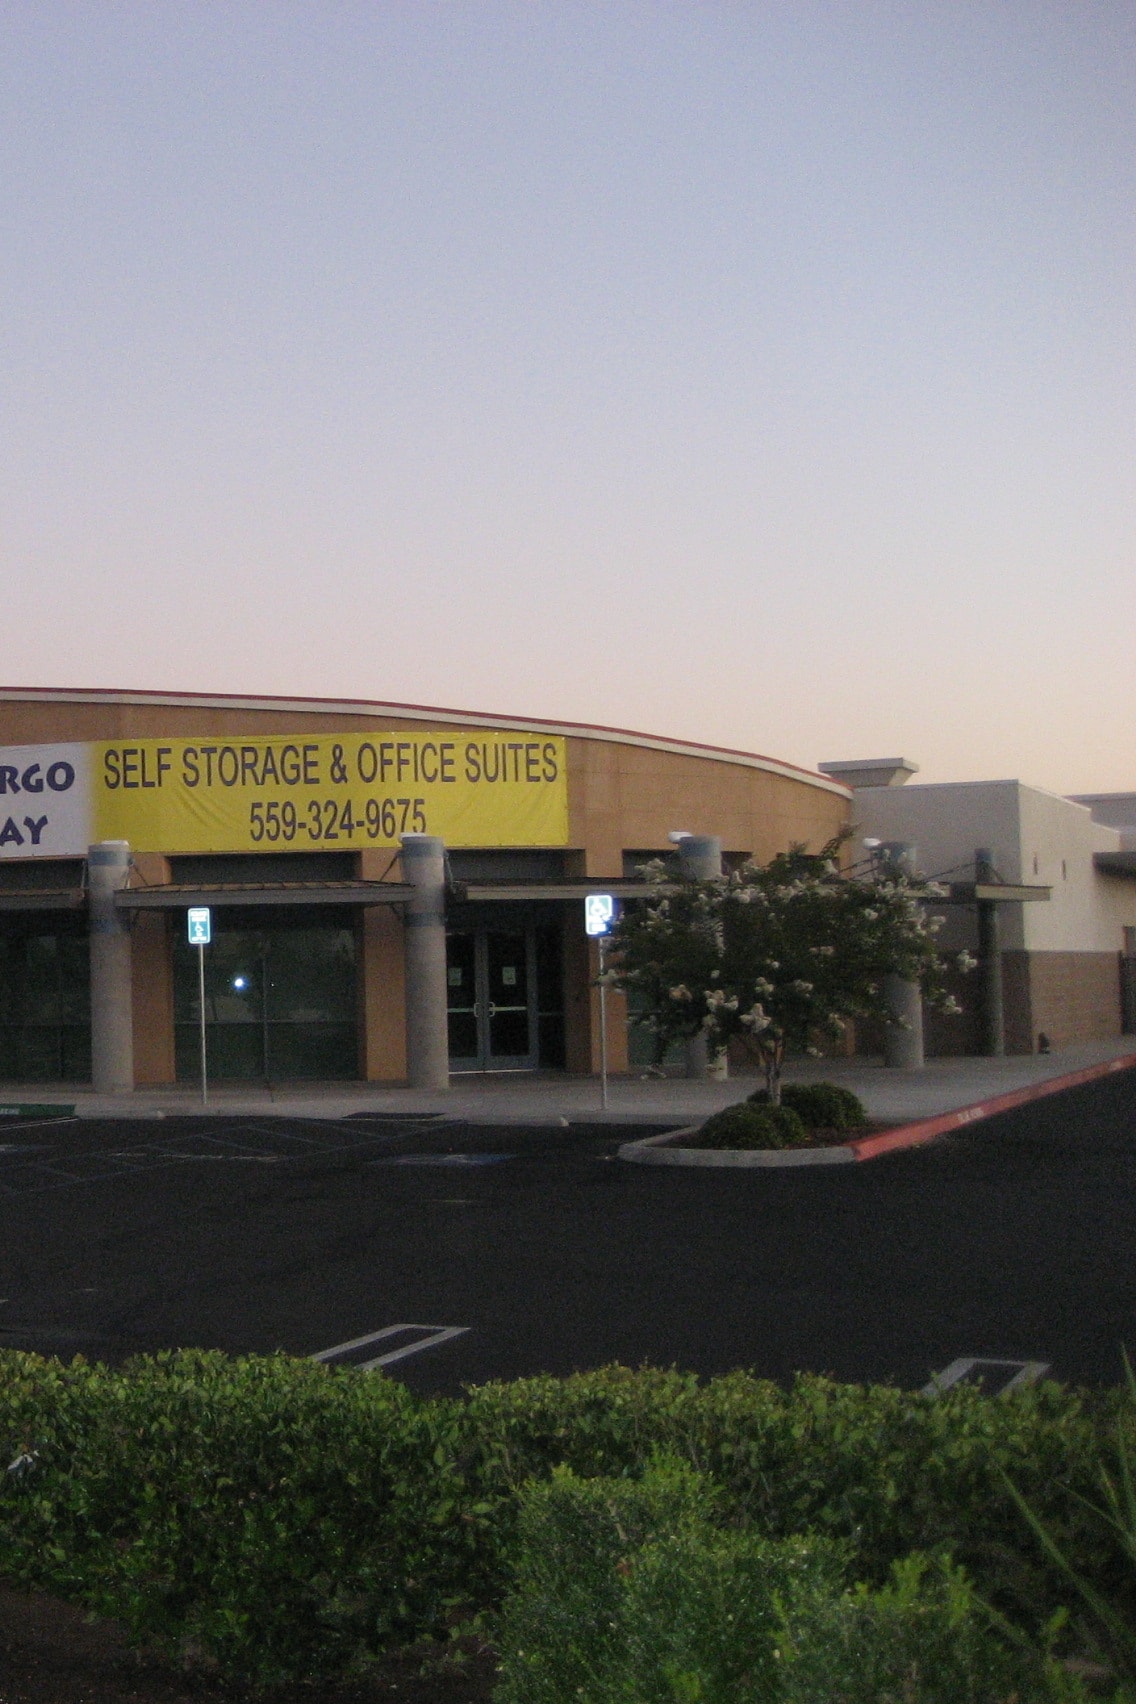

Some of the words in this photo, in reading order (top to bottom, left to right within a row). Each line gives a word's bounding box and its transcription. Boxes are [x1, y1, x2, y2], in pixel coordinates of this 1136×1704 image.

[104, 748, 172, 789] SELF
[182, 744, 320, 787] STORAGE
[330, 743, 348, 784] &
[357, 742, 456, 783] OFFICE
[465, 742, 558, 783] SUITES
[250, 798, 426, 841] 559-324-9675
